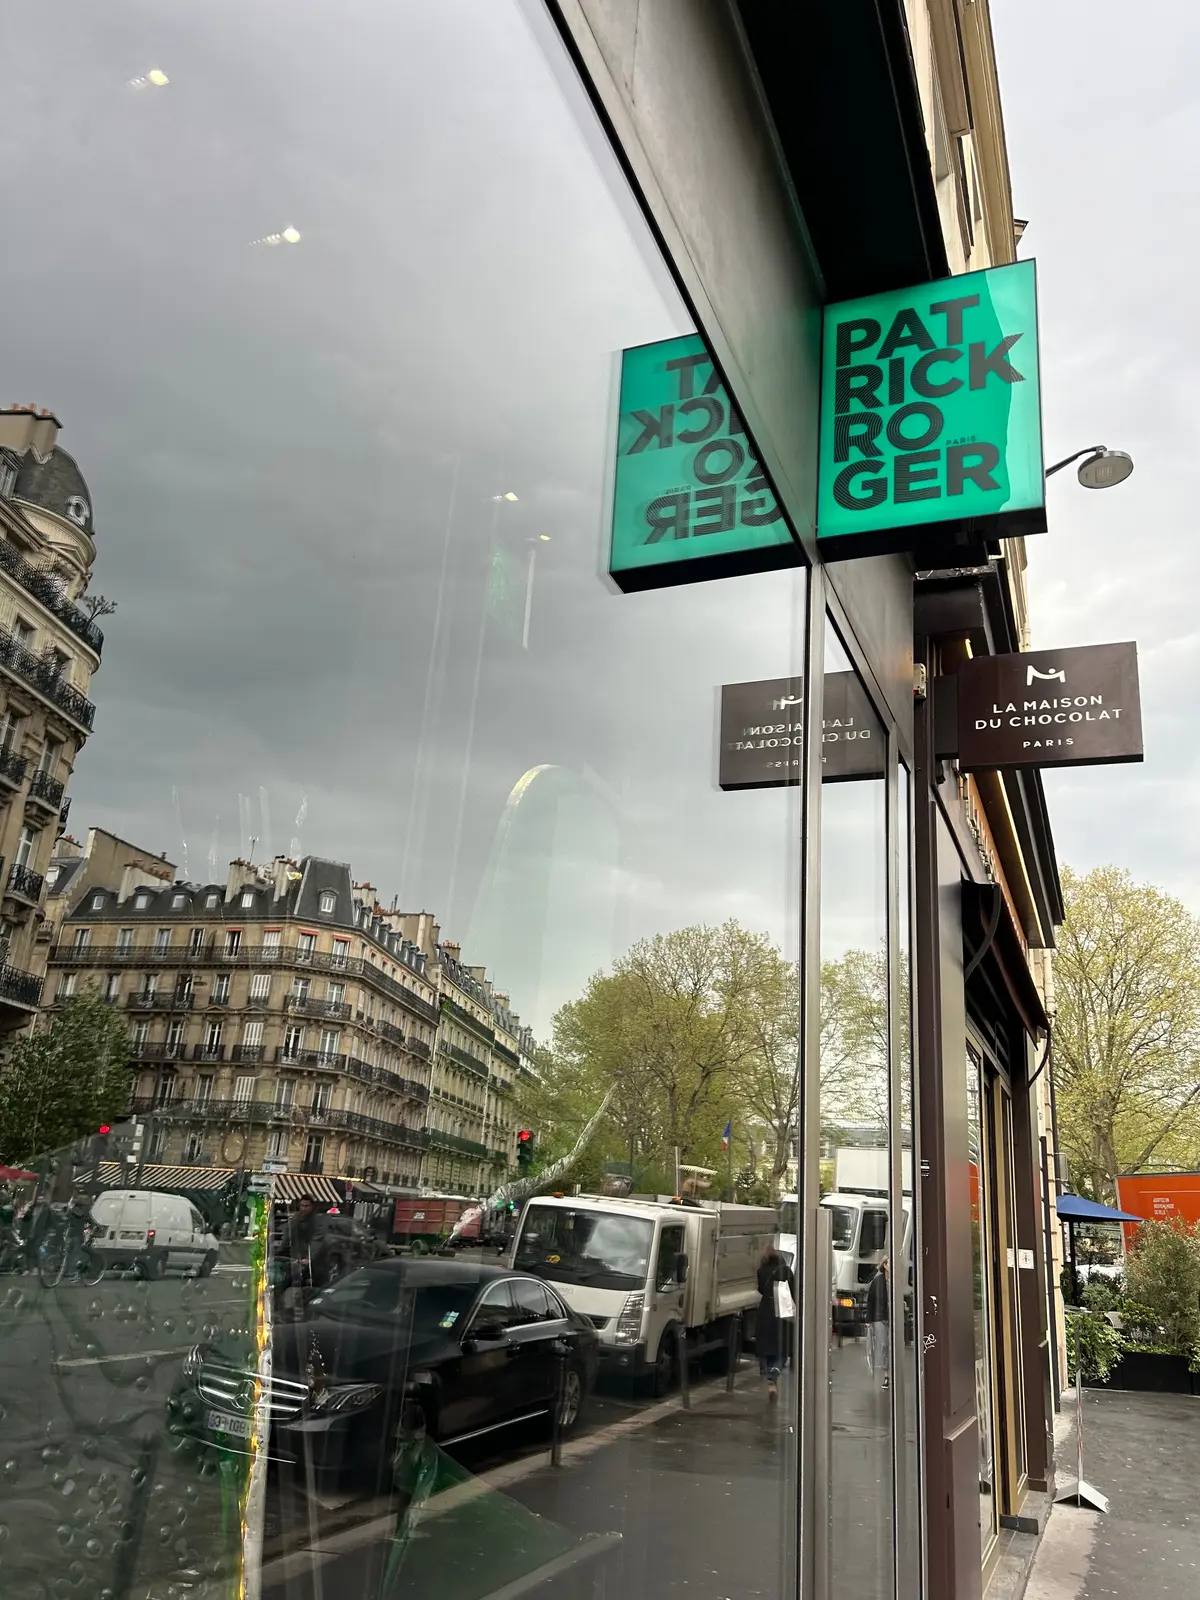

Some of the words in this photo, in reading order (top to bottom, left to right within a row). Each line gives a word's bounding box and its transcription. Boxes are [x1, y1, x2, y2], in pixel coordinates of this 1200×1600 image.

[836, 294, 980, 367] PAT
[834, 332, 1026, 415] RICK
[834, 401, 944, 463] RO
[946, 436, 976, 446] PARIS
[833, 442, 1002, 511] GER
[975, 718, 1001, 730] DU
[1009, 708, 1123, 727] CHOCOLAT
[993, 702, 1017, 714] LA
[1023, 695, 1103, 711] MAISON
[1023, 738, 1074, 749] PARIS
